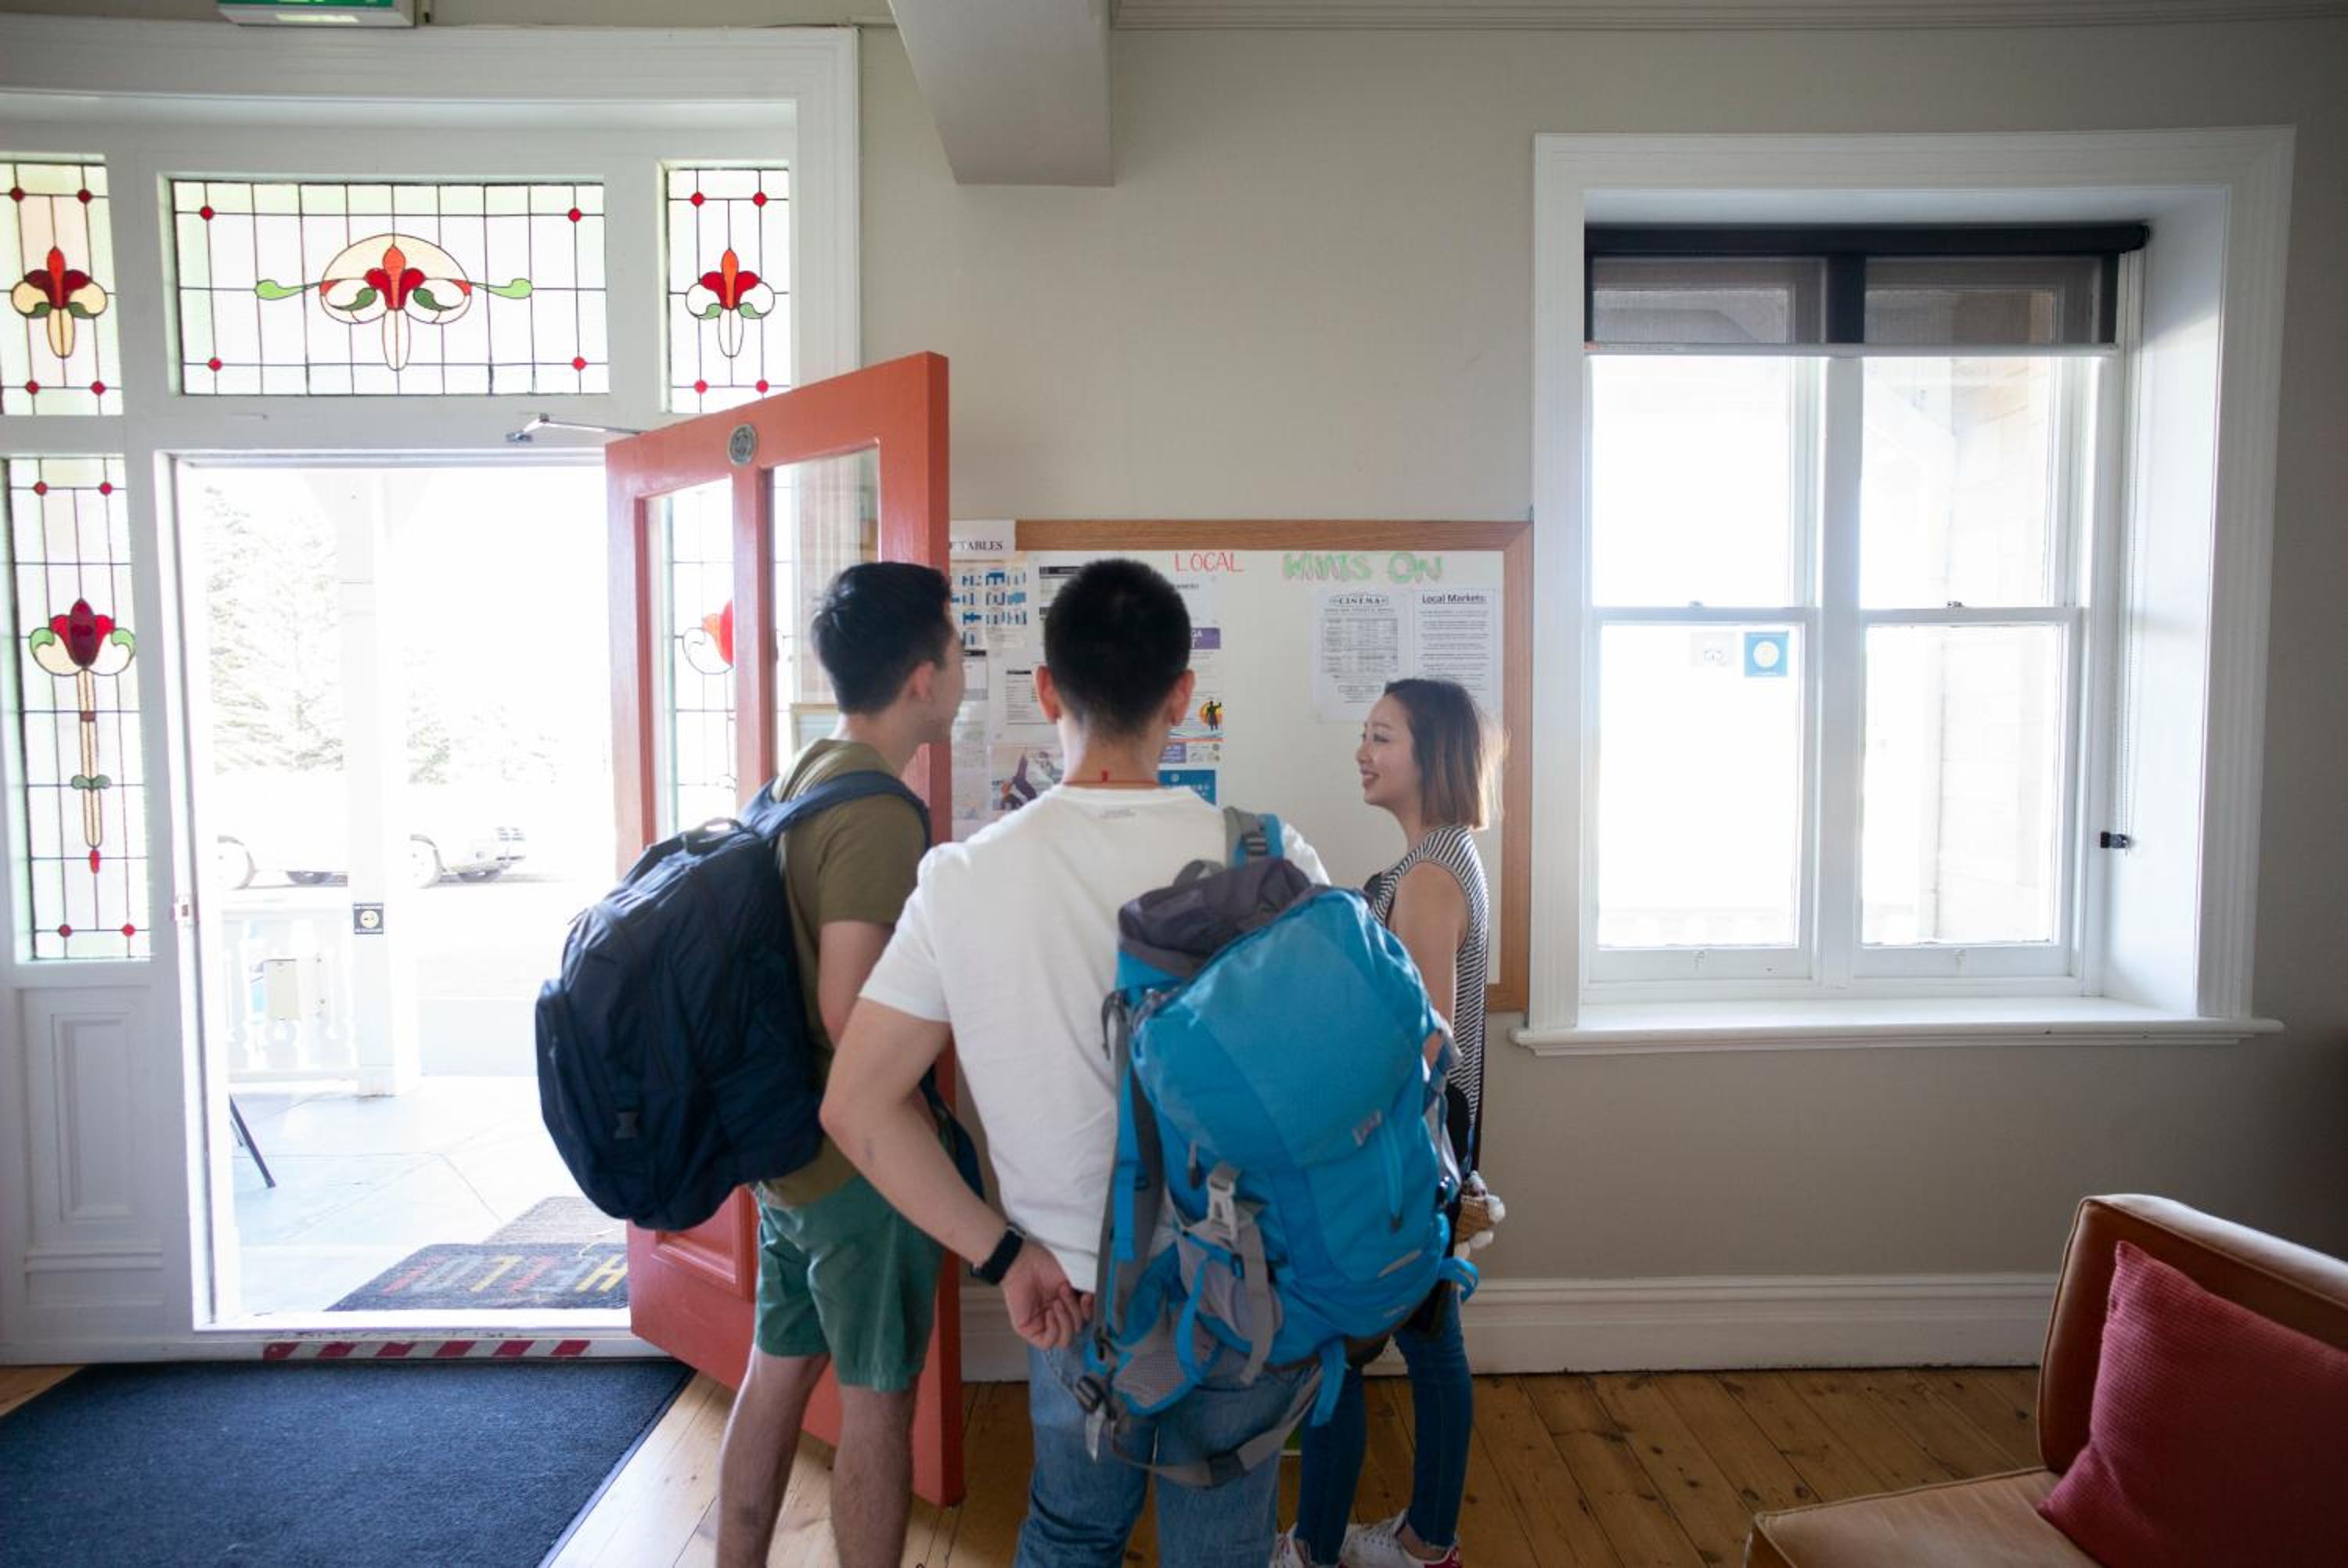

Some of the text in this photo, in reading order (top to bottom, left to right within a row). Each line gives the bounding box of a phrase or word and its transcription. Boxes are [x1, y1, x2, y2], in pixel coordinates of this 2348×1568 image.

[1175, 552, 1245, 573] LOCAL
[1387, 551, 1445, 584] ON
[1422, 593, 1446, 605] Local
